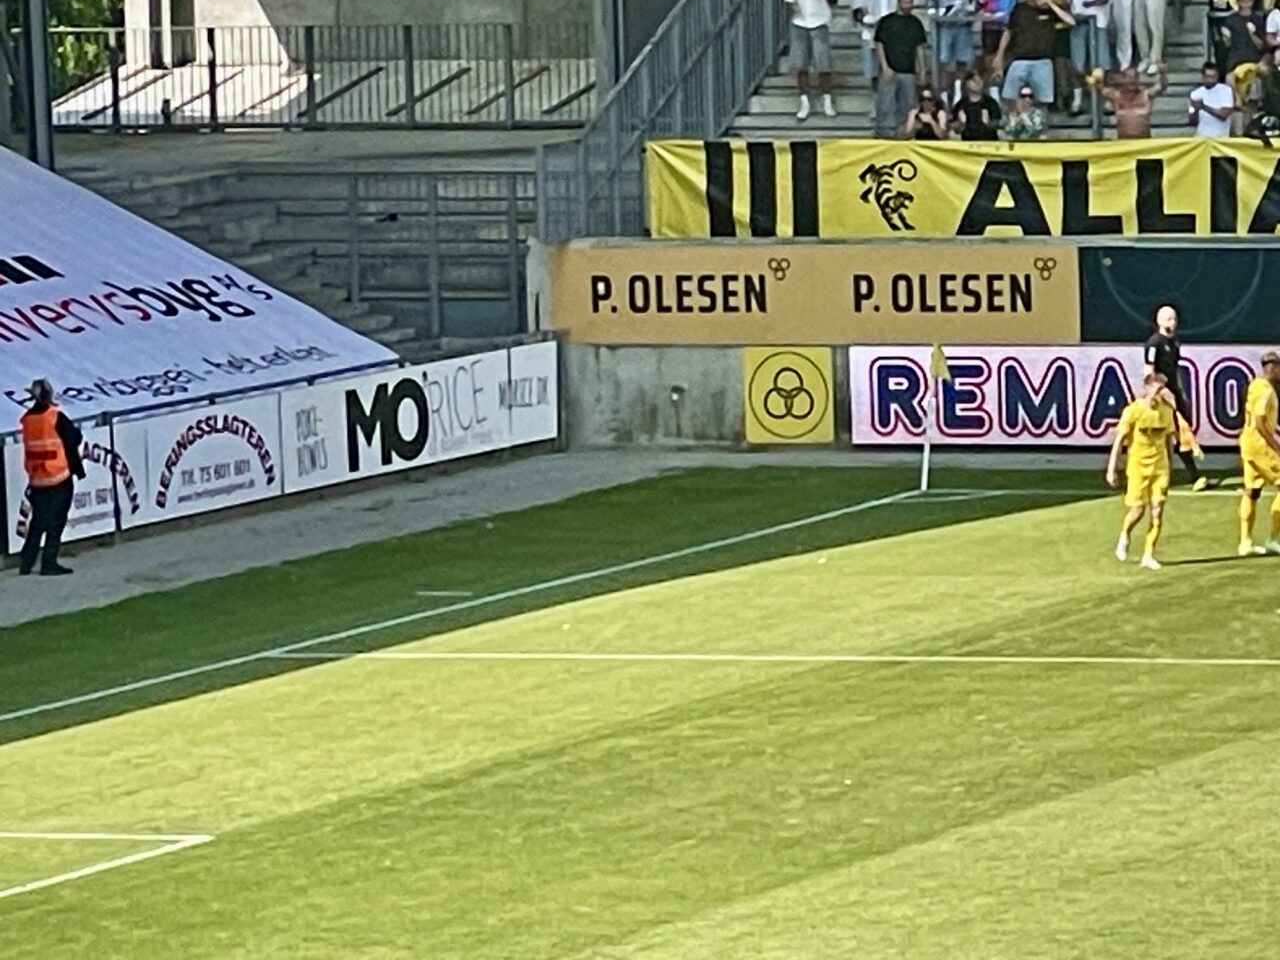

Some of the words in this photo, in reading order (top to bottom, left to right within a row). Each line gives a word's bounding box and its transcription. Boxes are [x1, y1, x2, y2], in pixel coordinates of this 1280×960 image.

[590, 275, 618, 313] P.
[628, 274, 768, 314] OLESEN
[853, 274, 881, 313] P.
[892, 274, 1033, 313] OLESEN
